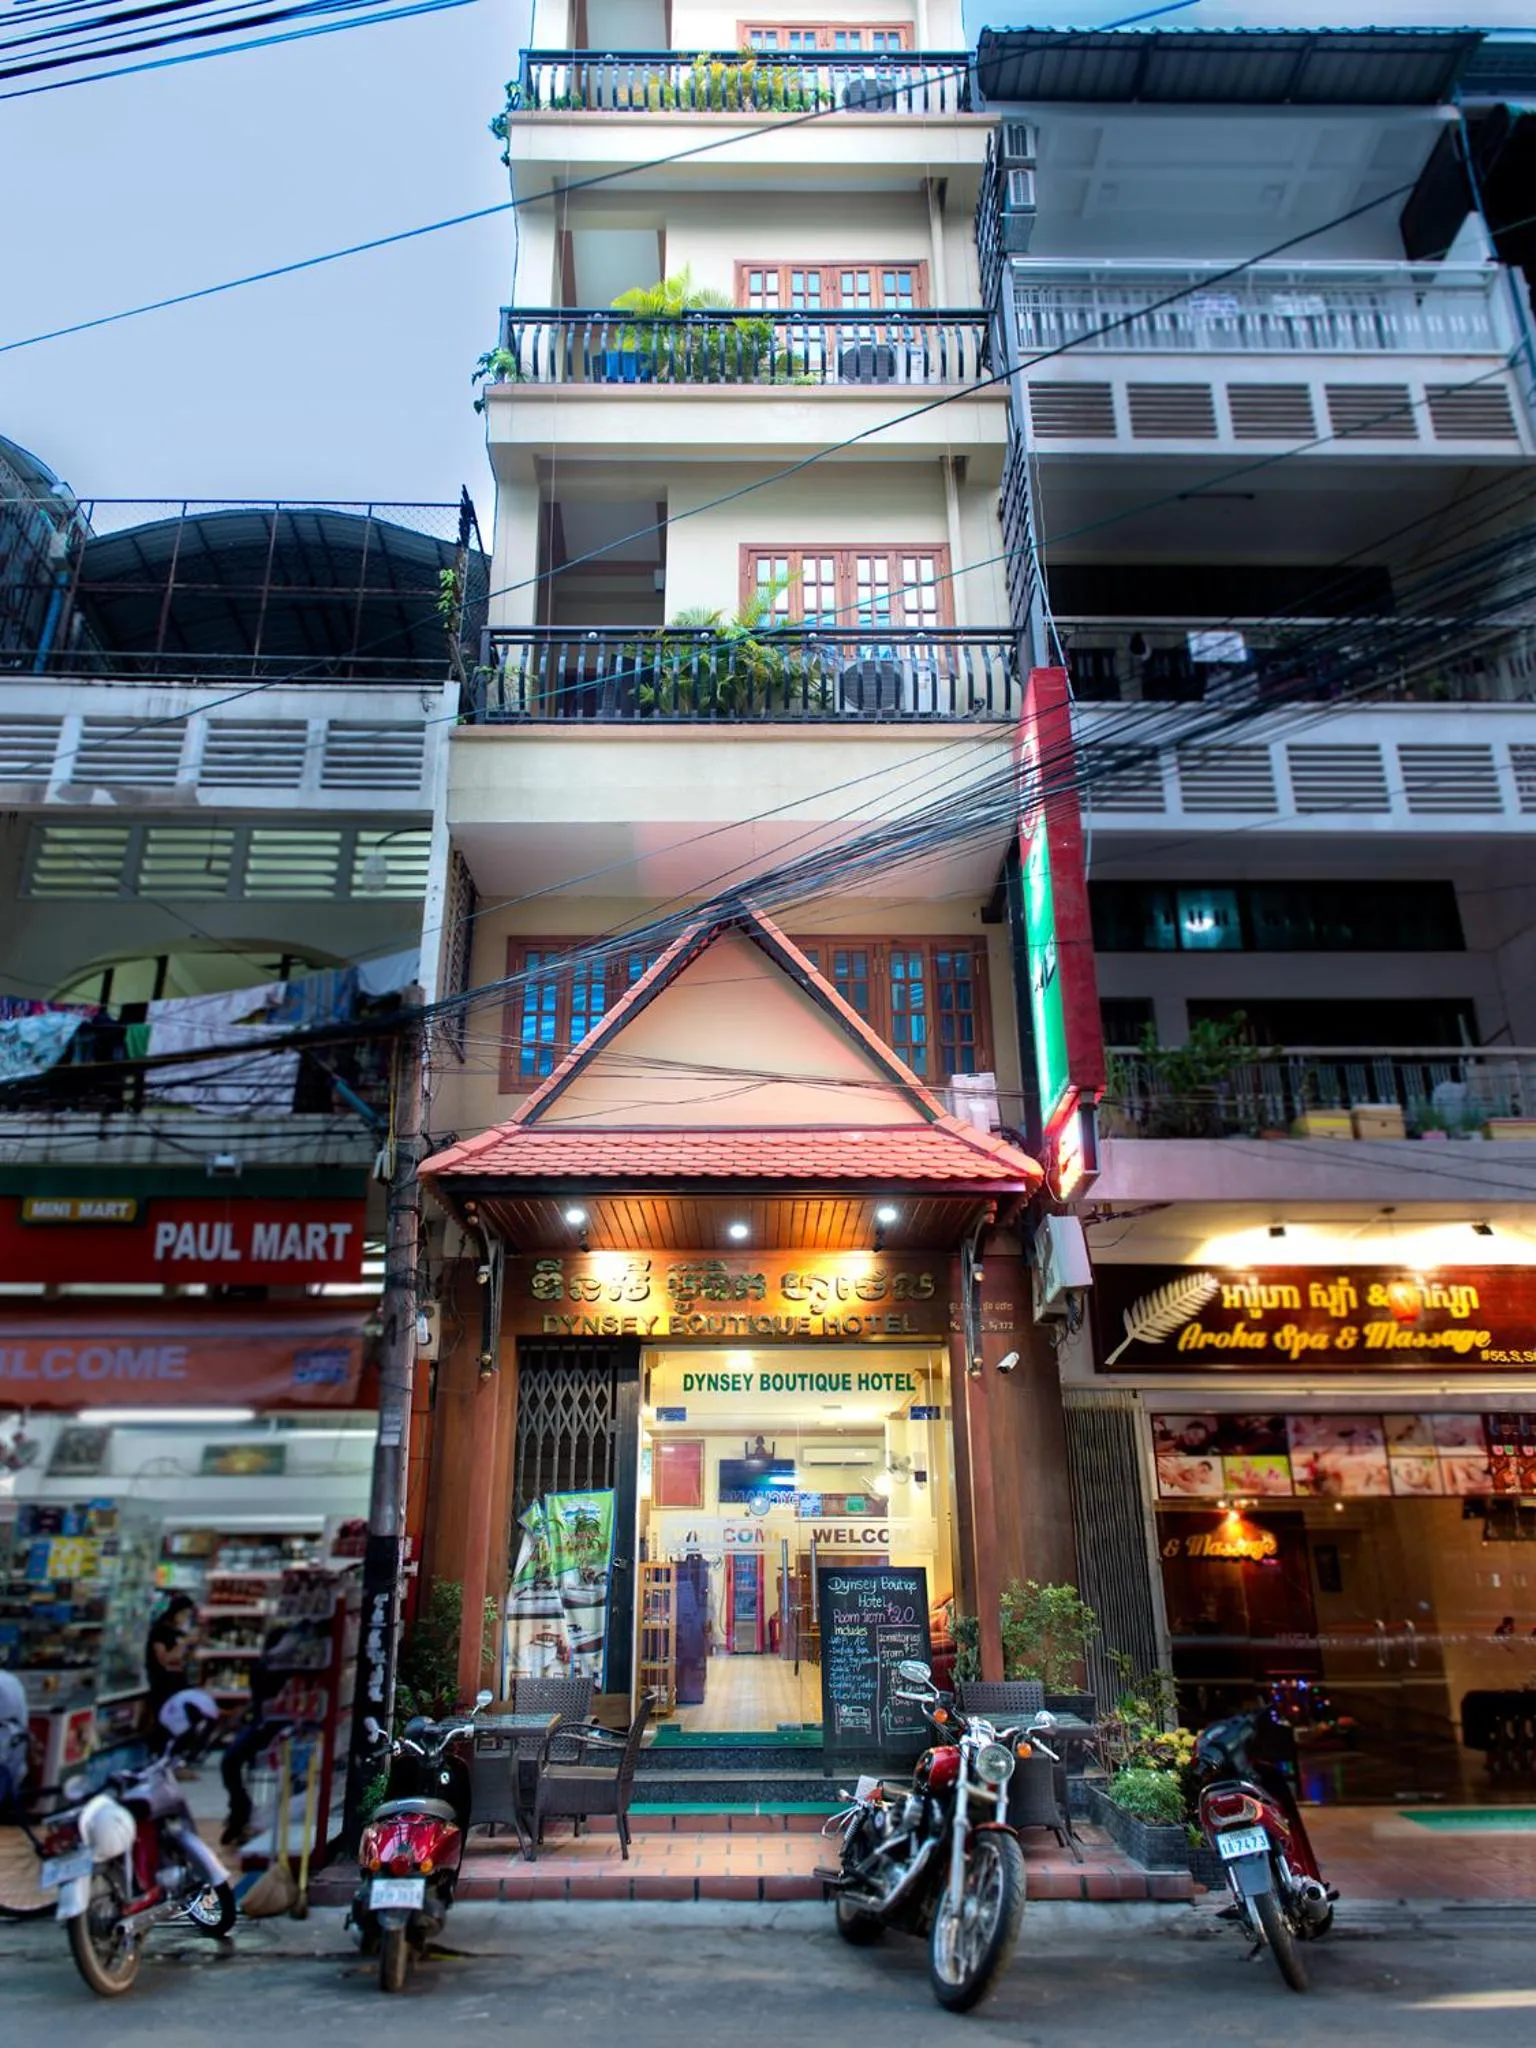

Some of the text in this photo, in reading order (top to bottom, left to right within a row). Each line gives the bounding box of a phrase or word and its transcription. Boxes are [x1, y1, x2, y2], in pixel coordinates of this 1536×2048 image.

[31, 1202, 129, 1218] MINI MART
[154, 1222, 352, 1261] PAUL MART
[1367, 1283, 1388, 1307] &
[542, 1313, 919, 1336] DYNSEY BOUTIQUE HOTEL
[1178, 1322, 1492, 1360] Aroha Spa & Massage
[0, 1346, 189, 1381] LCOME
[683, 1373, 916, 1393] DYNSEY BOUTIQUE HOTEL
[1162, 1538, 1180, 1558] &
[828, 1576, 877, 1596] Dynsey
[858, 1594, 886, 1608] Hotel
[833, 1608, 860, 1623] Room
[886, 1602, 914, 1624] $20
